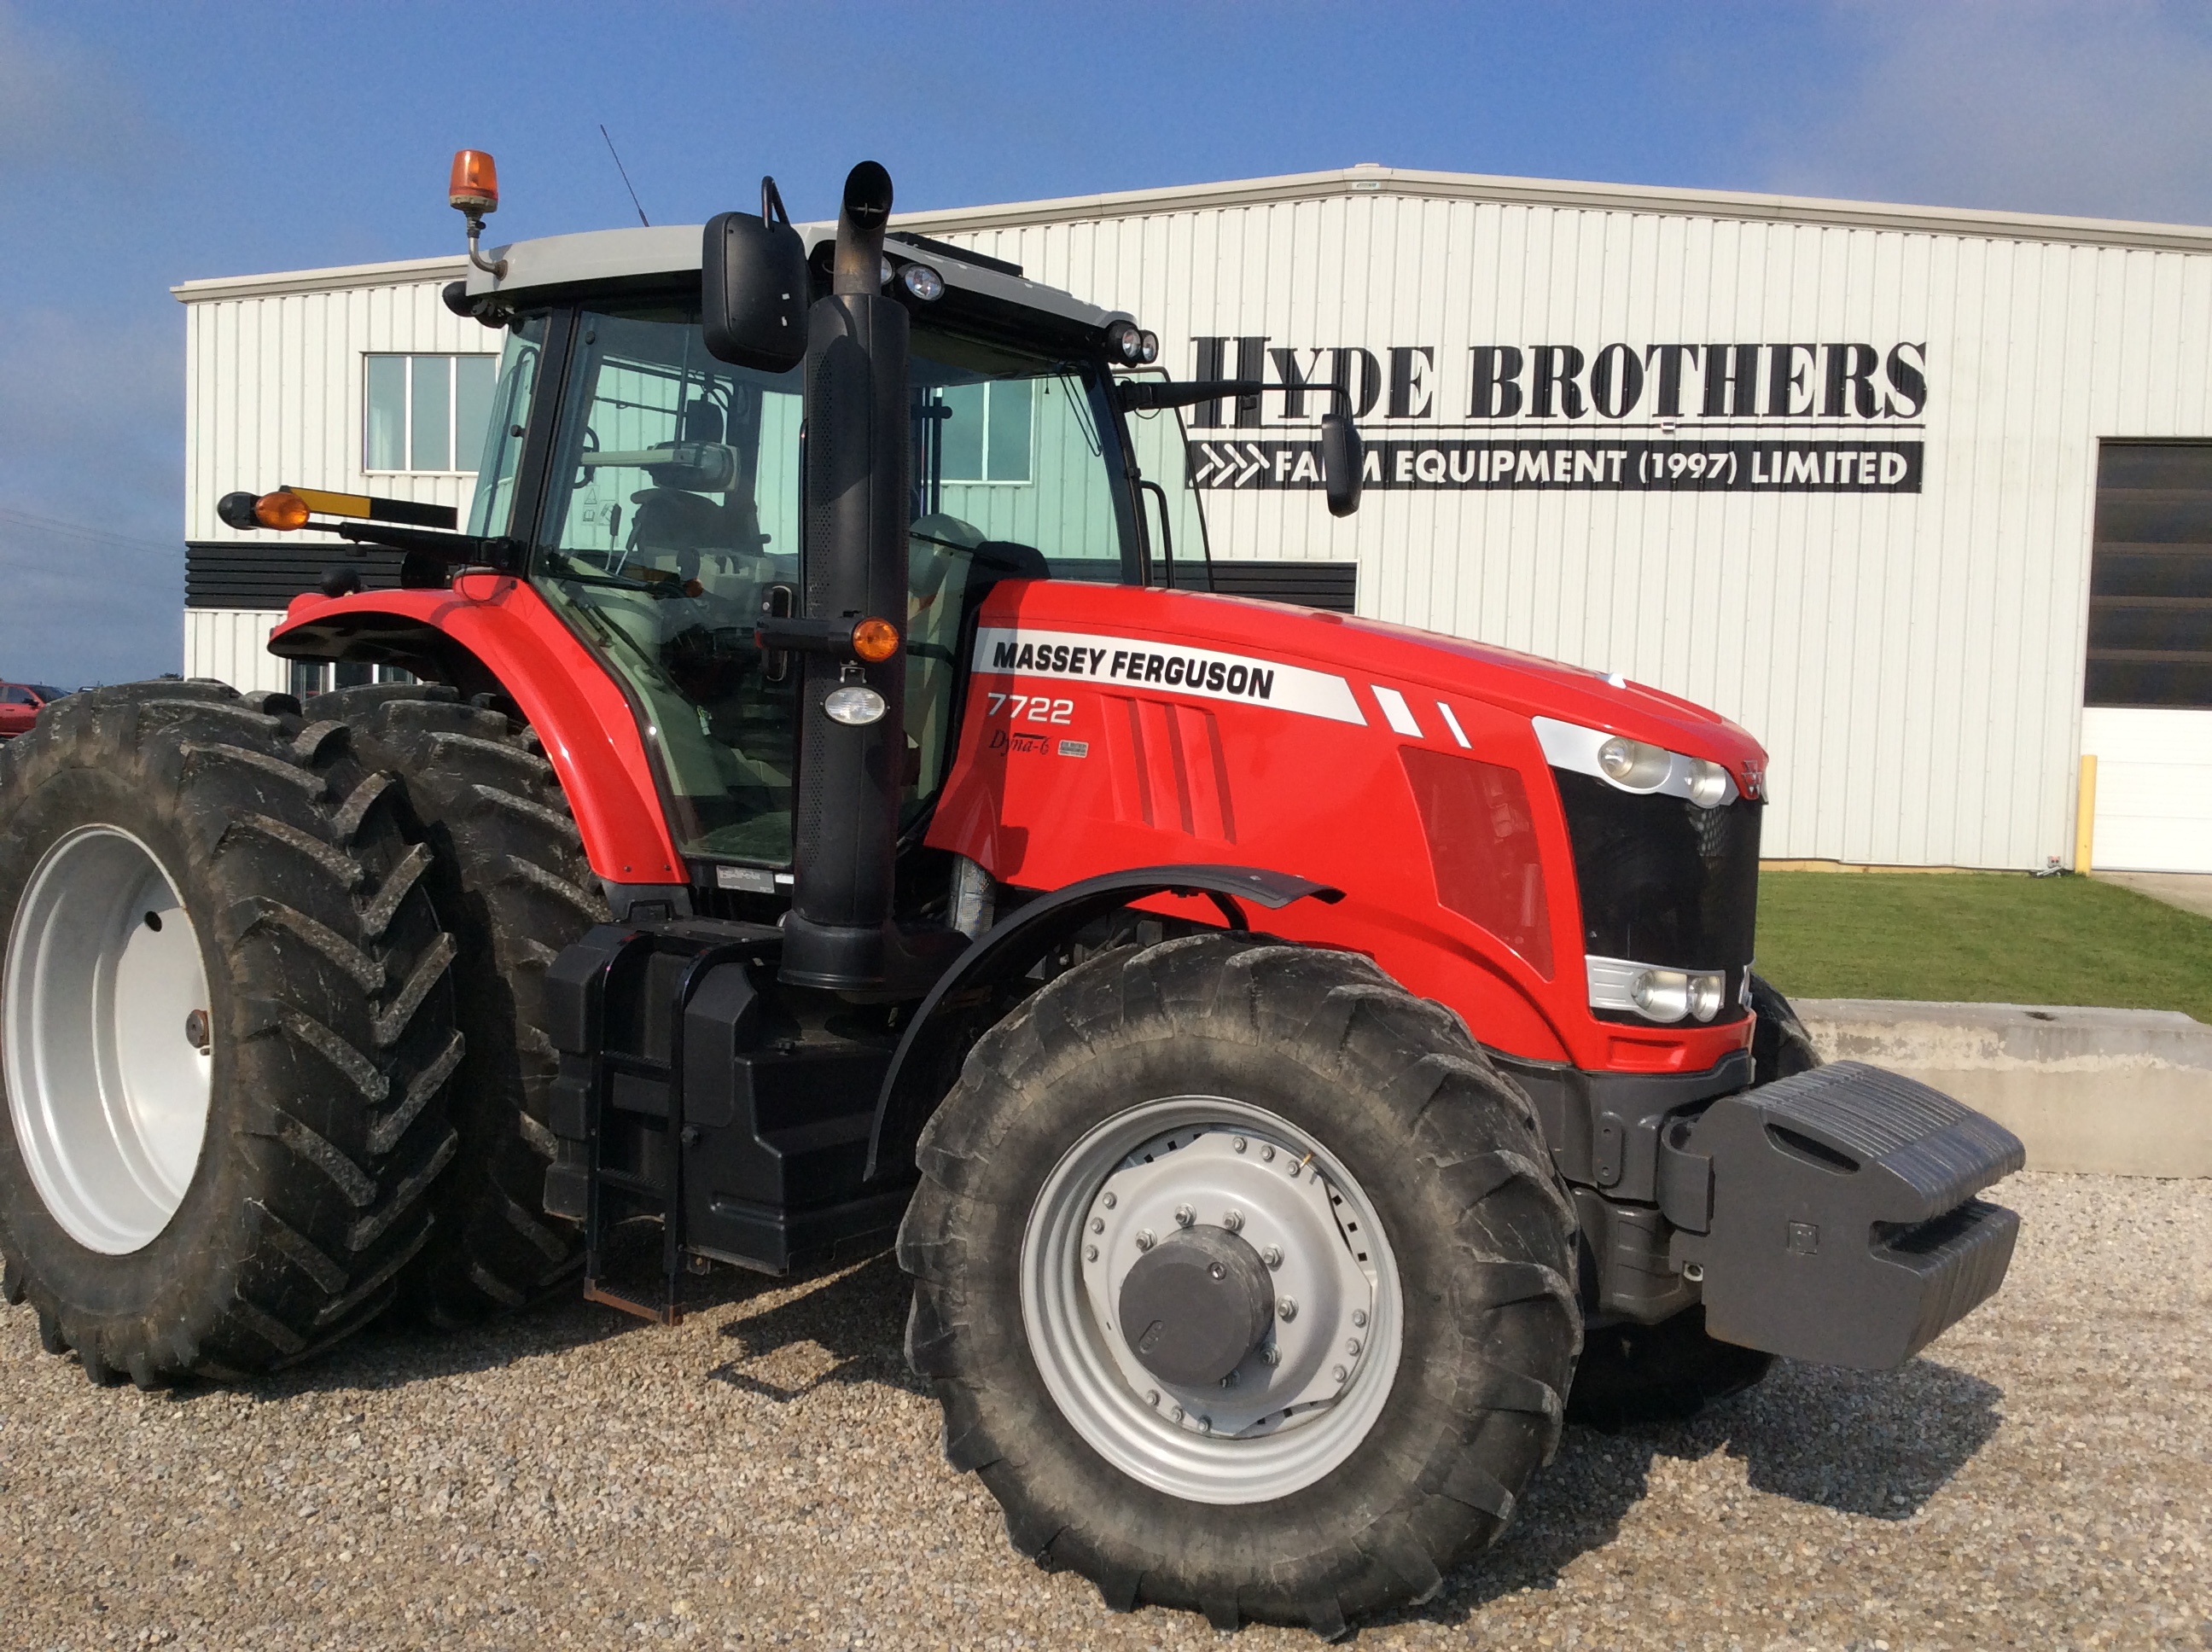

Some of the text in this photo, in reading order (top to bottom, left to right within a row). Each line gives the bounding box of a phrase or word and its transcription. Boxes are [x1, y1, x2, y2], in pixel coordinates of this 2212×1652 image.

[1187, 336, 1928, 429] HYDE BROTHERS
[1275, 450, 1907, 485] FAM EQUIPMENT (1997) LIMITED
[992, 642, 1275, 700] MASSEY FERGUSON
[987, 692, 1074, 724] 7722
